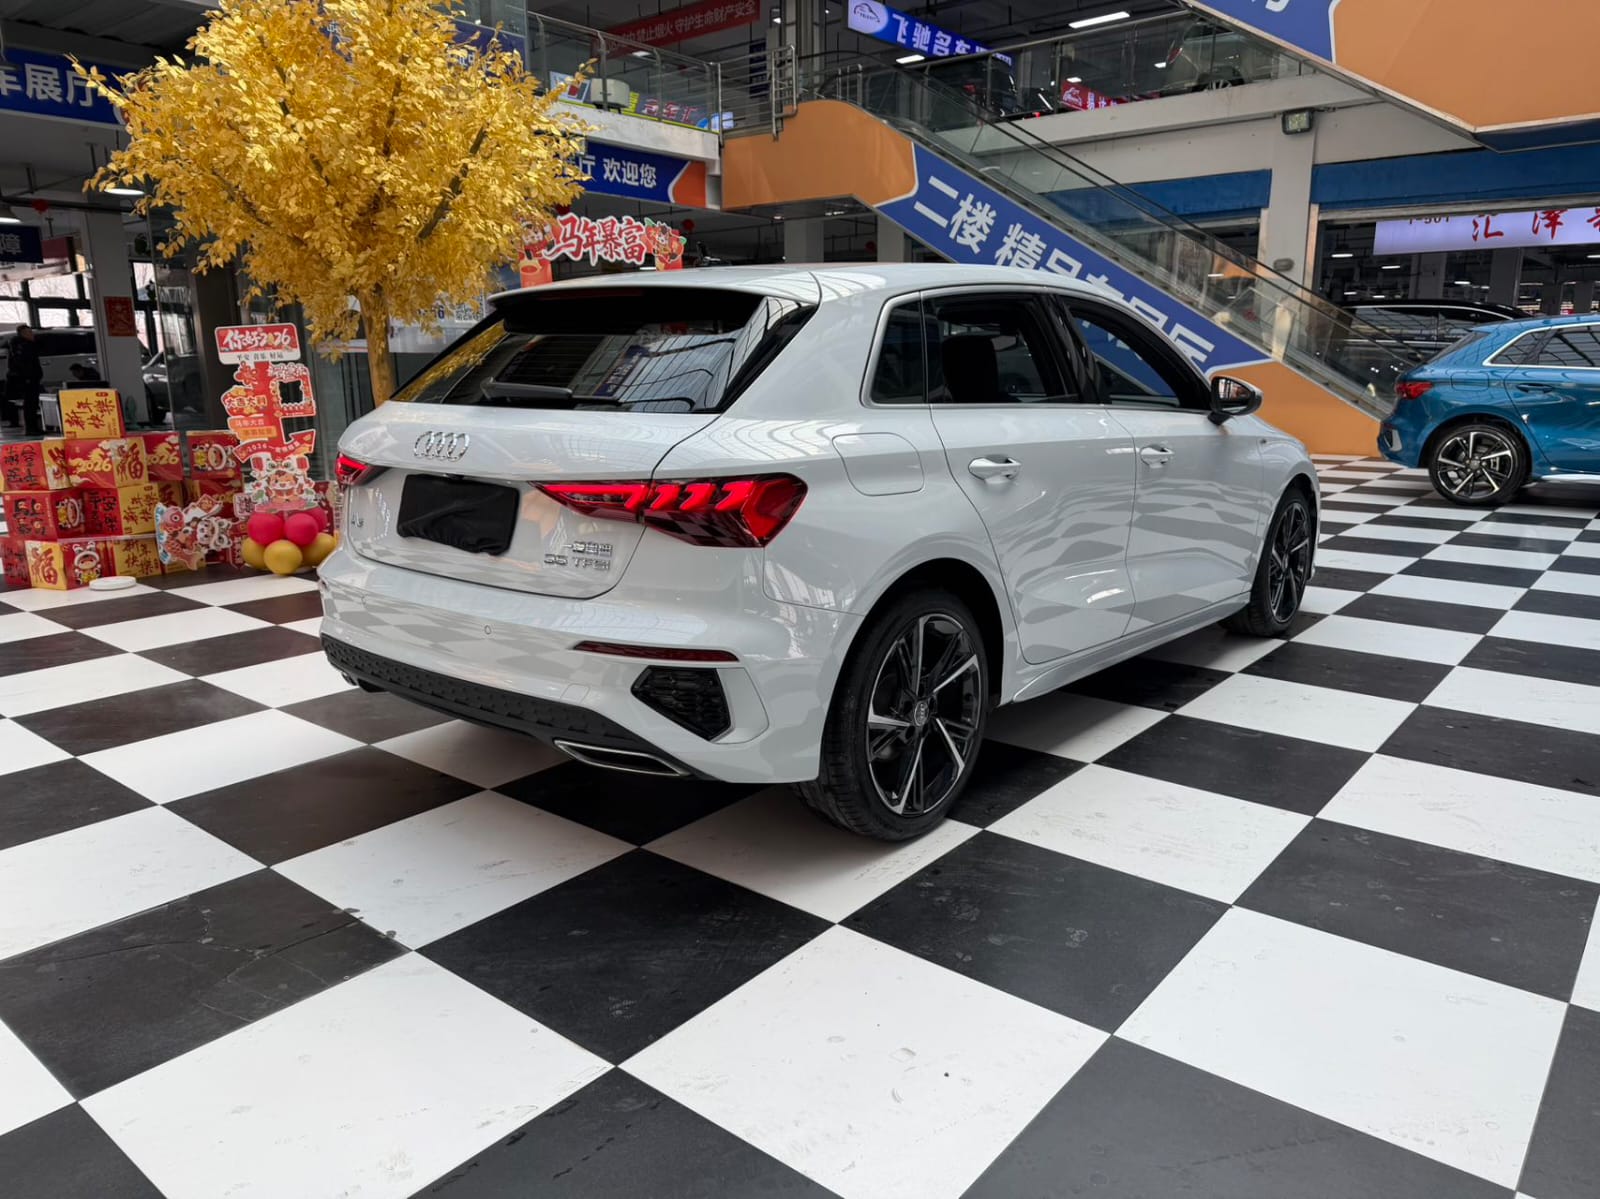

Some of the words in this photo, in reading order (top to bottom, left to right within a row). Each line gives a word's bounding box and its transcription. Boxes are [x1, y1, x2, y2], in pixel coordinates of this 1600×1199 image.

[603, 158, 657, 188] 欢迎您
[914, 175, 997, 254] 二楼
[543, 213, 647, 266] 马年暴富
[77, 459, 112, 473] 2026
[116, 442, 145, 481] 福
